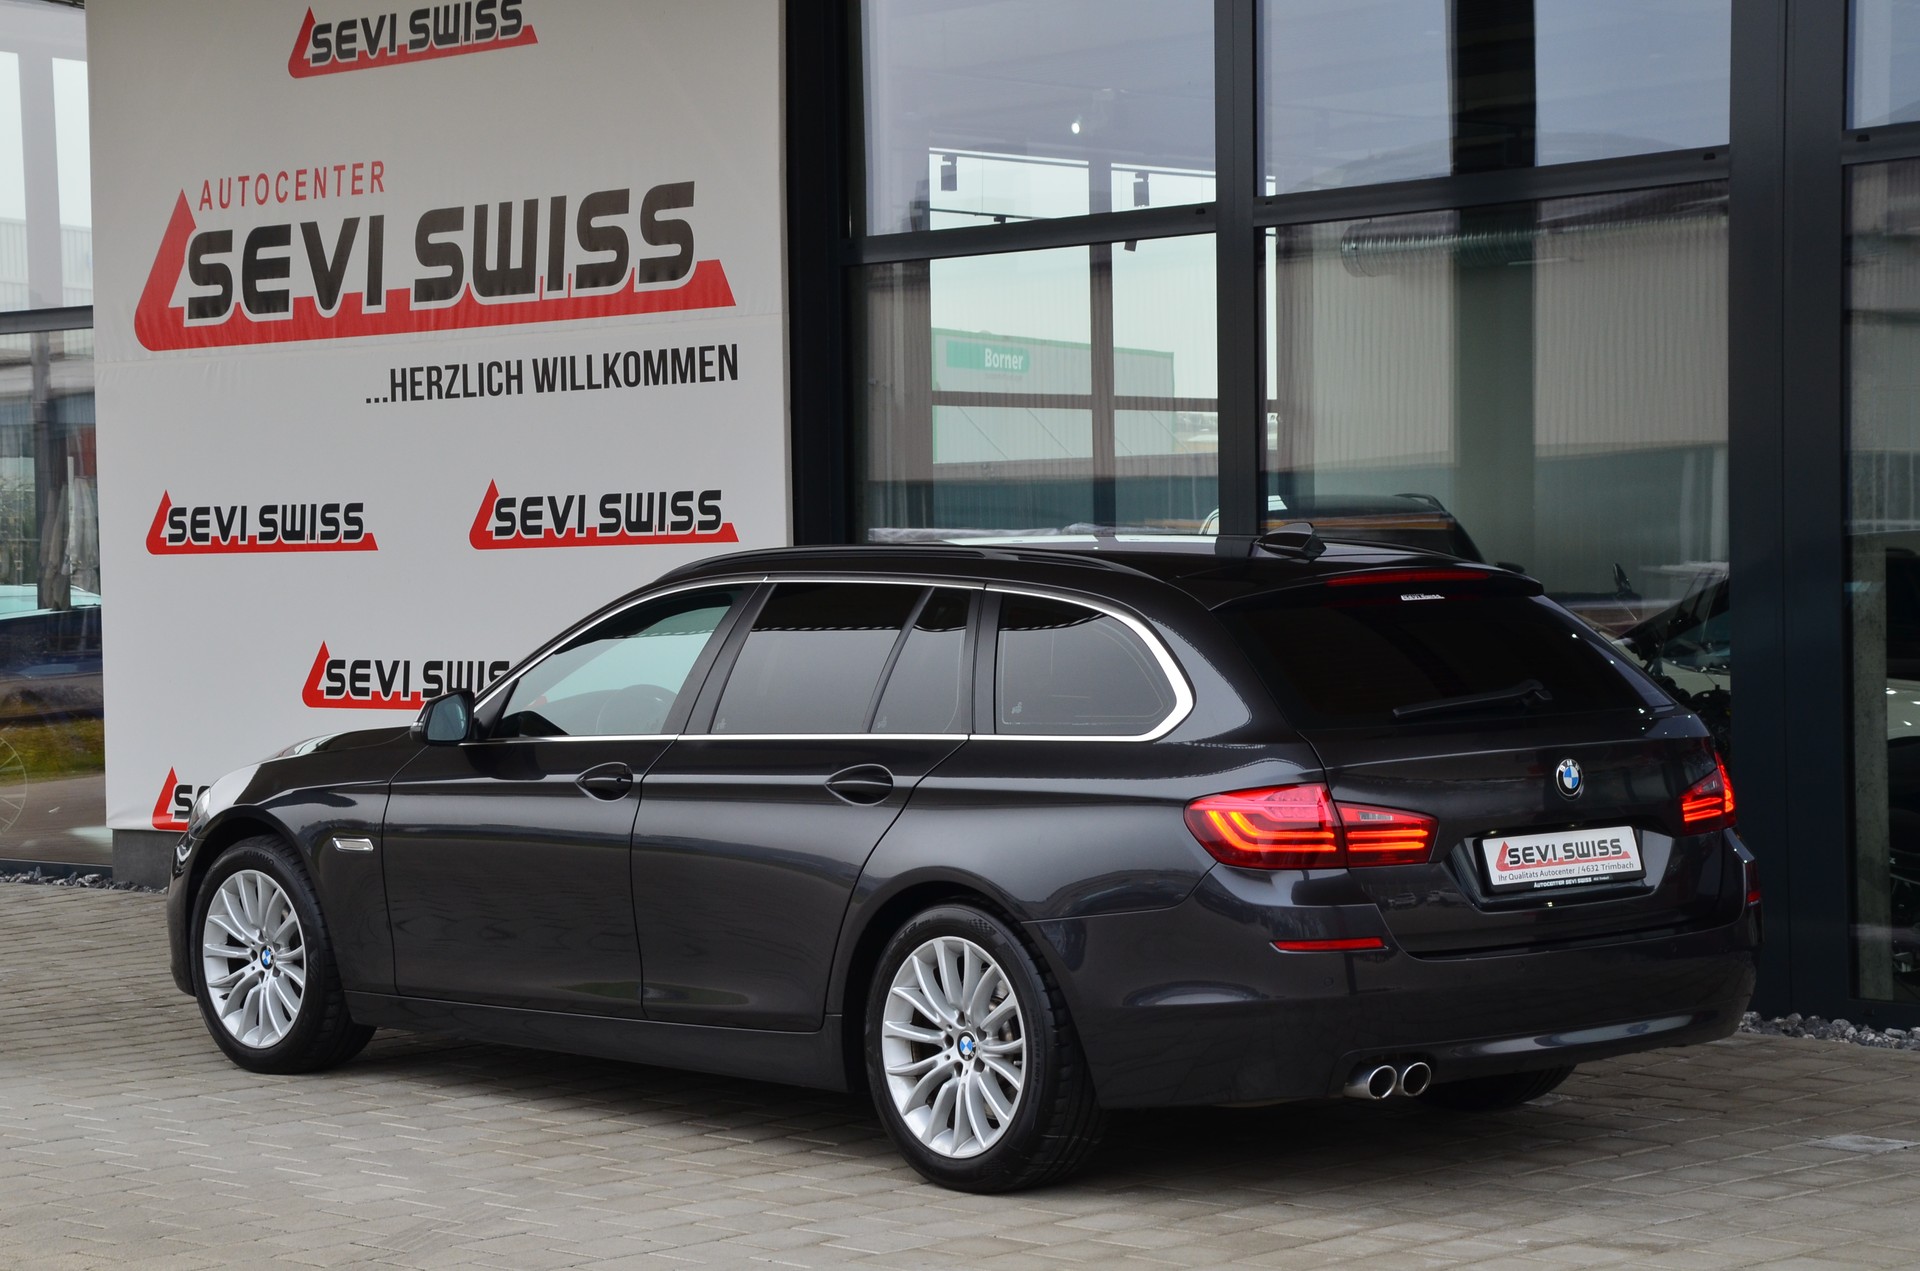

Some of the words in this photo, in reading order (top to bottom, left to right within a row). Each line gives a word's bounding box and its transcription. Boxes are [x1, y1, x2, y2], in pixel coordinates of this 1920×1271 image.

[311, 13, 397, 64] SEVI
[408, 0, 522, 50] SWISS
[198, 160, 385, 211] AUTOCENTER
[188, 214, 385, 320] SEVI
[414, 180, 695, 303] SWISS
[366, 359, 524, 404] ...HERZLICH
[532, 343, 739, 394] WILLKOMMEN
[985, 348, 1024, 371] Borner
[168, 505, 248, 543] SEVI
[258, 502, 364, 542] SWISS
[494, 494, 586, 537] SEVI
[598, 489, 722, 534] SWISS
[325, 659, 411, 698] SEVI
[422, 660, 510, 698] SWI
[1508, 844, 1558, 866] SEVI
[1562, 838, 1622, 860] SWISS
[1539, 867, 1575, 877] Autocenter
[1581, 864, 1599, 873] 4632
[1600, 861, 1634, 871] Trimbach
